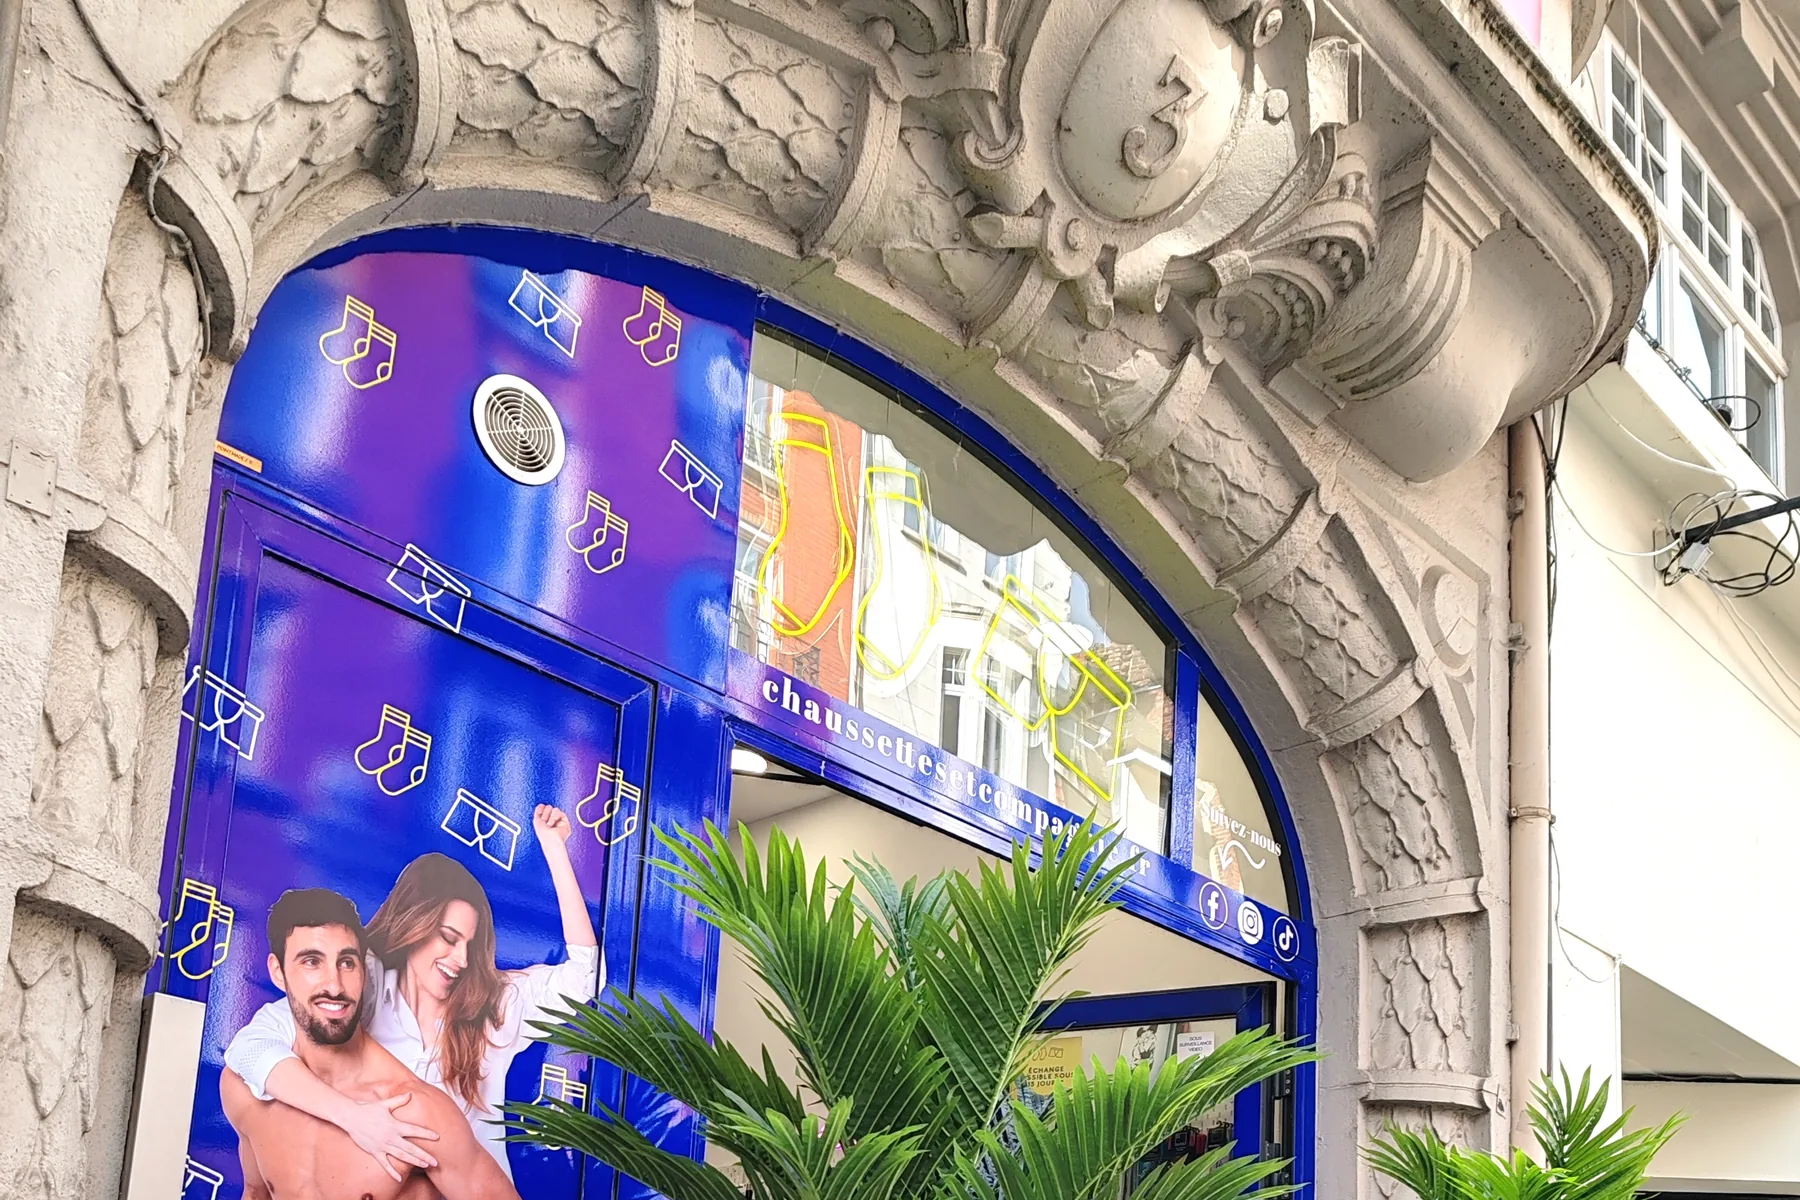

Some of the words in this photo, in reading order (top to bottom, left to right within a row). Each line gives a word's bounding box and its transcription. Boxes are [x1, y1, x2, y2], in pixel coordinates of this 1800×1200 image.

[762, 675, 1151, 877] chaussettesetcompagiefr
[1200, 801, 1282, 858] Suivez-nous
[1027, 1073, 1052, 1081] SSIBLE
